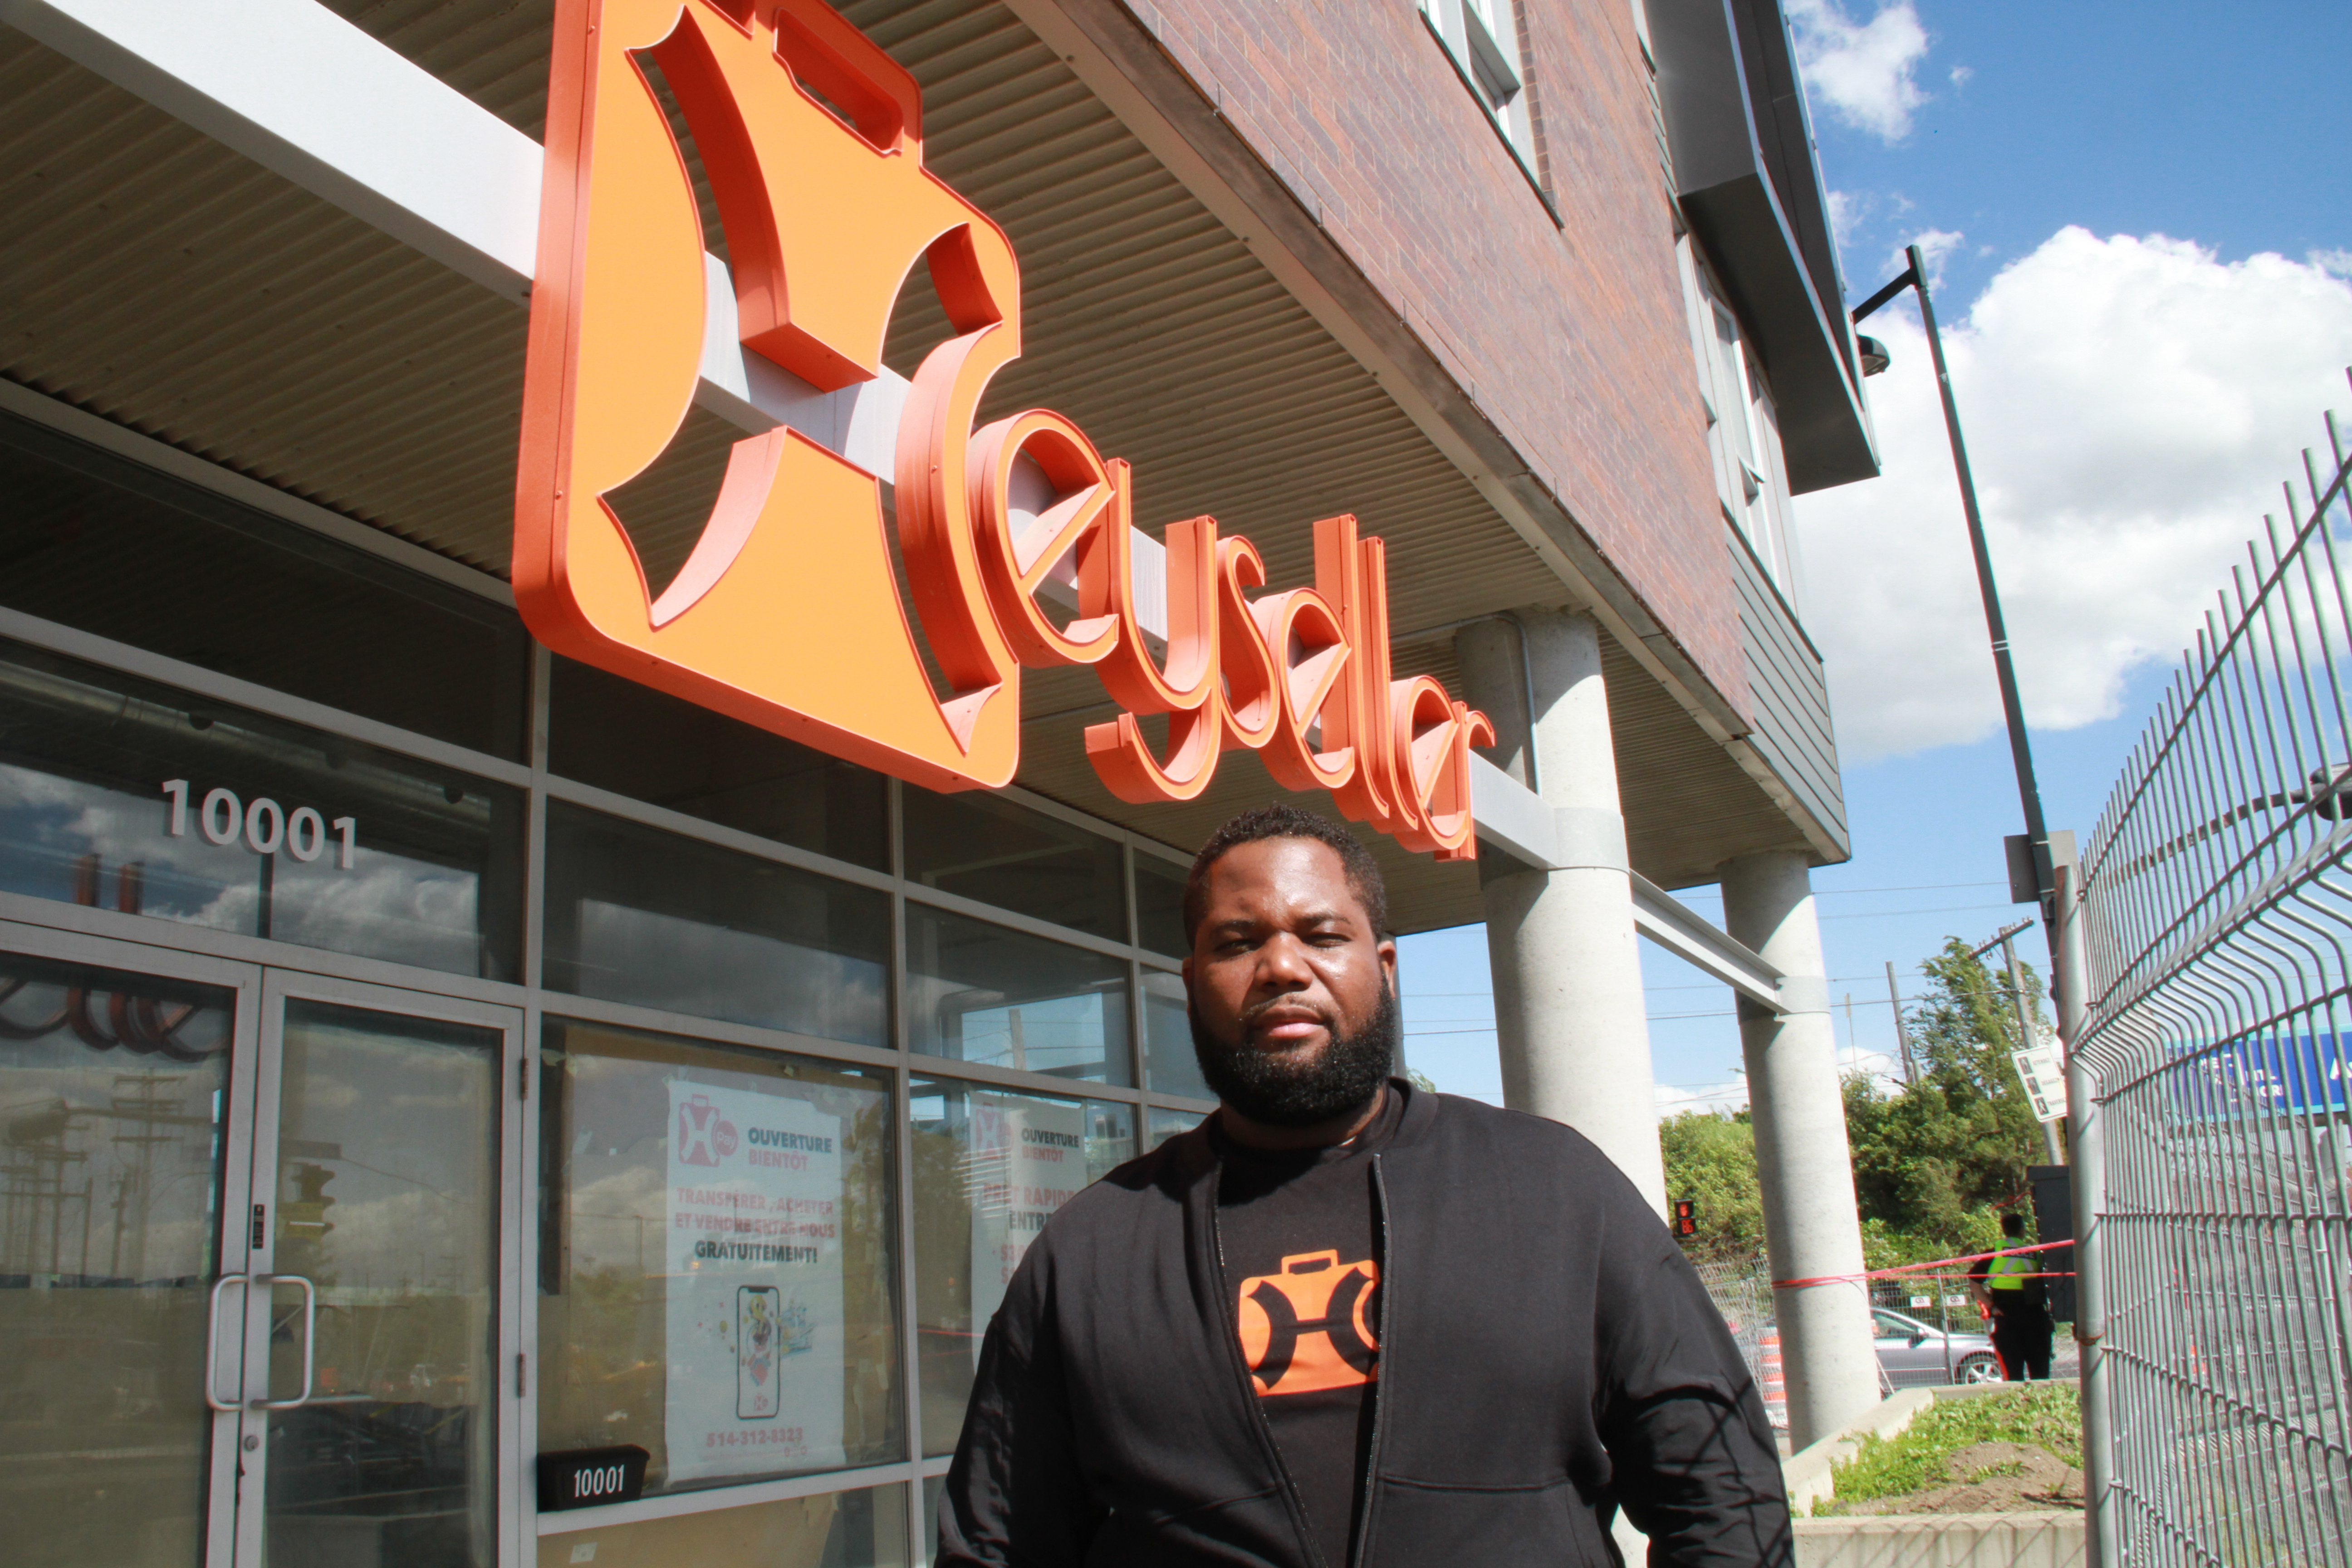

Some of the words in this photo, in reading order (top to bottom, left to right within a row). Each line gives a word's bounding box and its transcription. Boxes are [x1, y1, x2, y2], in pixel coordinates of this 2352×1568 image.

[162, 779, 355, 868] 10001
[748, 1127, 832, 1153] OUVERTURE
[1021, 1127, 1079, 1147] OUVERTURE
[749, 1148, 809, 1171] BIENTÔT
[1022, 1145, 1064, 1162] BIENTÔT
[777, 1197, 834, 1216] ACHETER
[676, 1212, 691, 1228] ET
[695, 1214, 751, 1233] VENDRE
[755, 1219, 796, 1235] ENTRE
[799, 1223, 836, 1238] NOUS
[695, 1240, 818, 1263] GRATUITEMENT!
[574, 1464, 624, 1497] 10001
